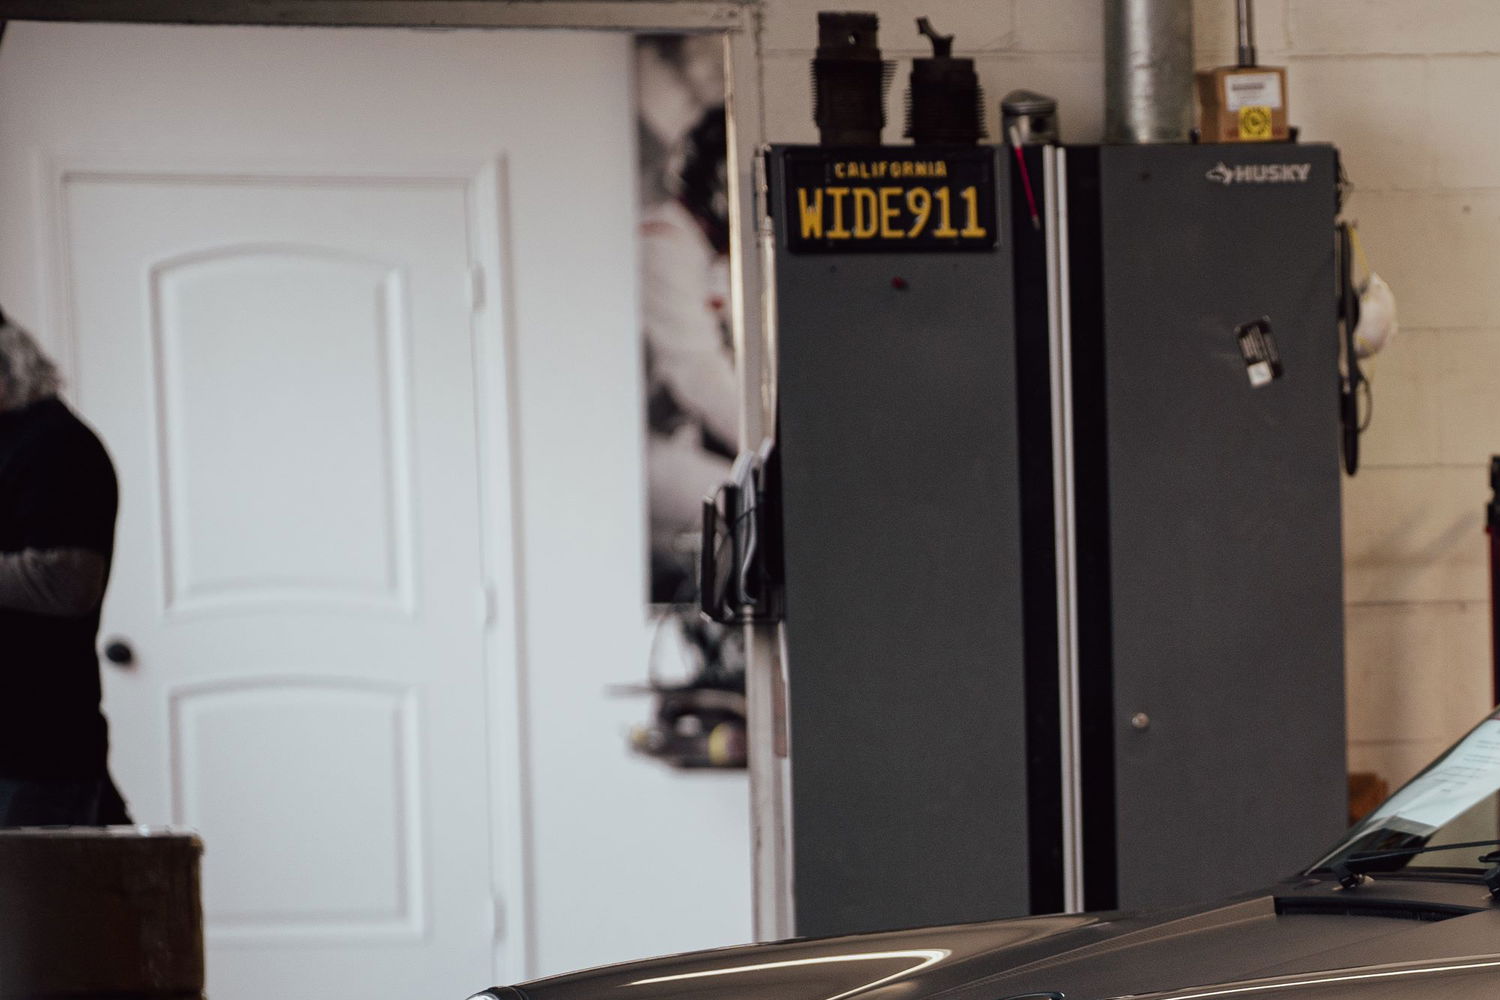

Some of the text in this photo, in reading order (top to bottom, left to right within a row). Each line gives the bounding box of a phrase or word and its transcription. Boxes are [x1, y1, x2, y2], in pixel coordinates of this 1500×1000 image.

[834, 160, 947, 179] CALIFORNIA
[1236, 163, 1311, 182] HUSKY
[798, 186, 986, 239] WIDE911
